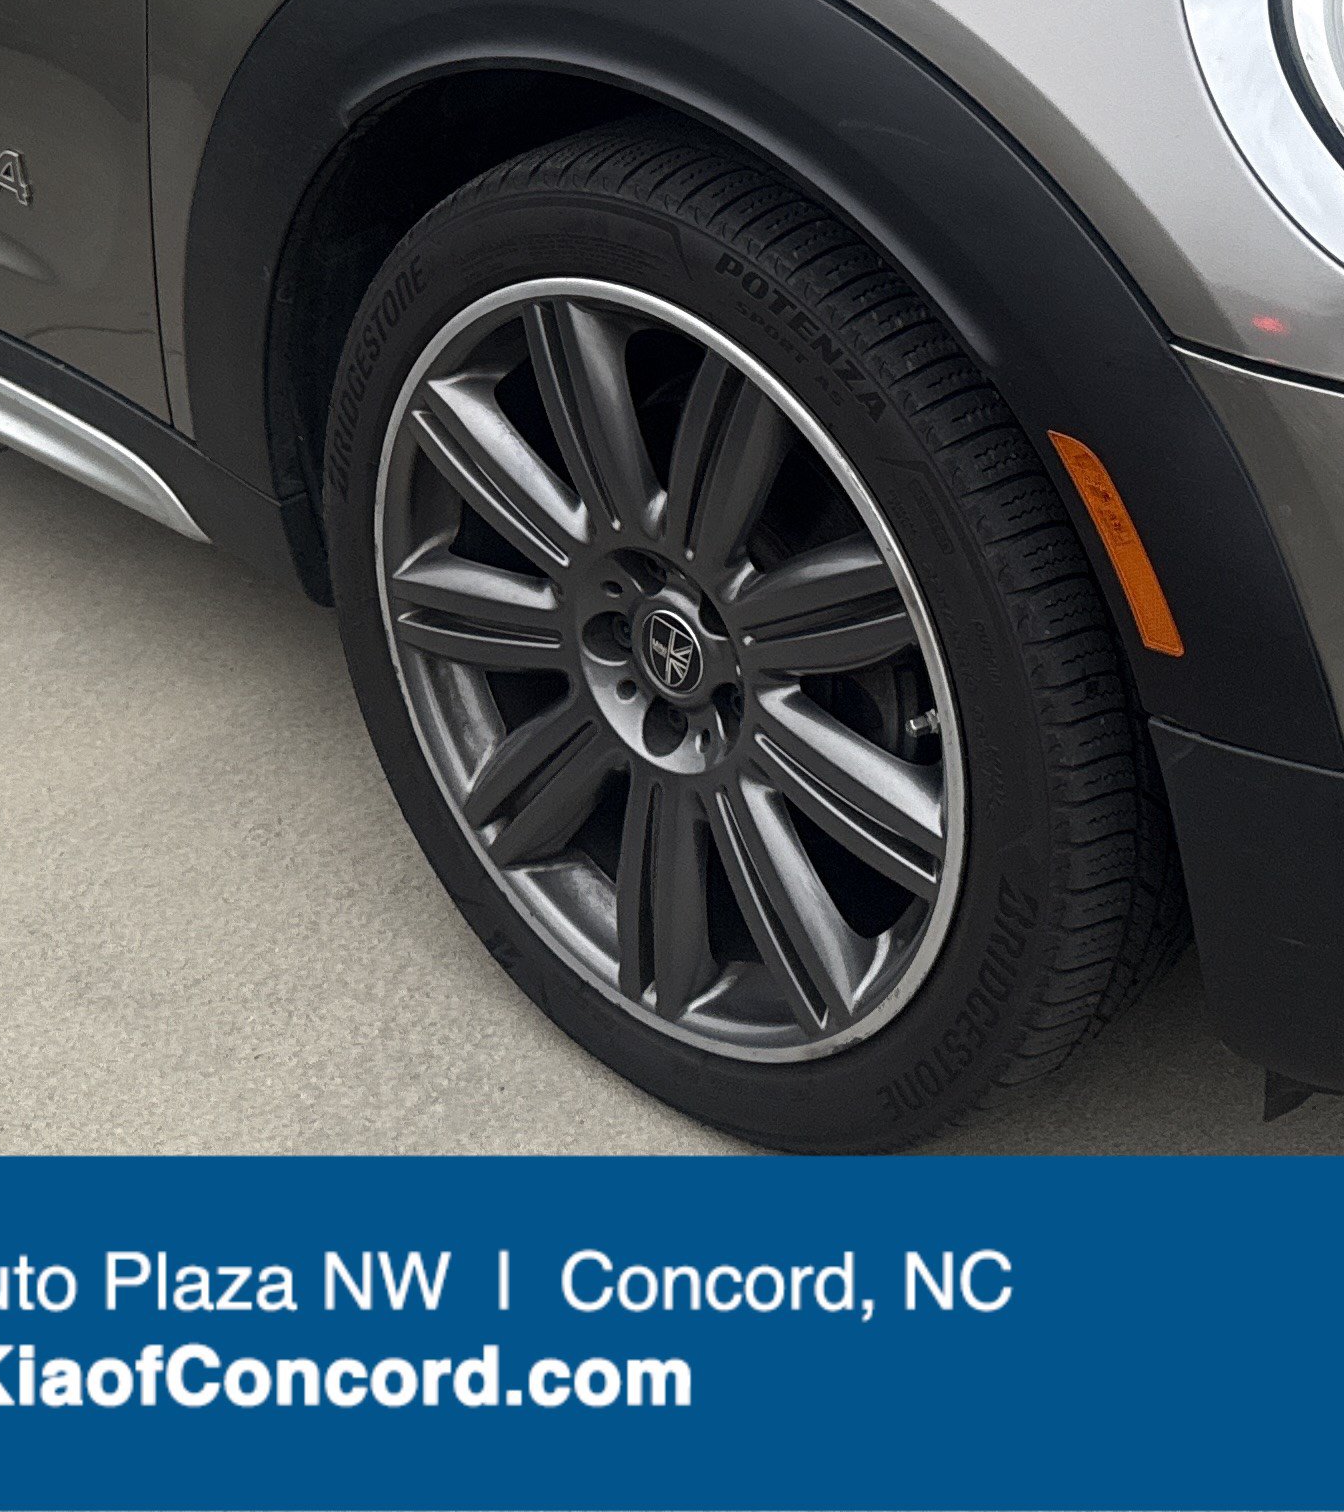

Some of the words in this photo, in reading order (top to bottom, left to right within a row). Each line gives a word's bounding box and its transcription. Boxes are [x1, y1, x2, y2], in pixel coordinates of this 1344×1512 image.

[328, 253, 431, 503] BRIDGESTONE
[714, 251, 888, 424] POTENZA
[735, 300, 810, 365] SPORT
[814, 374, 845, 408] AS
[875, 874, 1040, 1122] BRIDGESTONE
